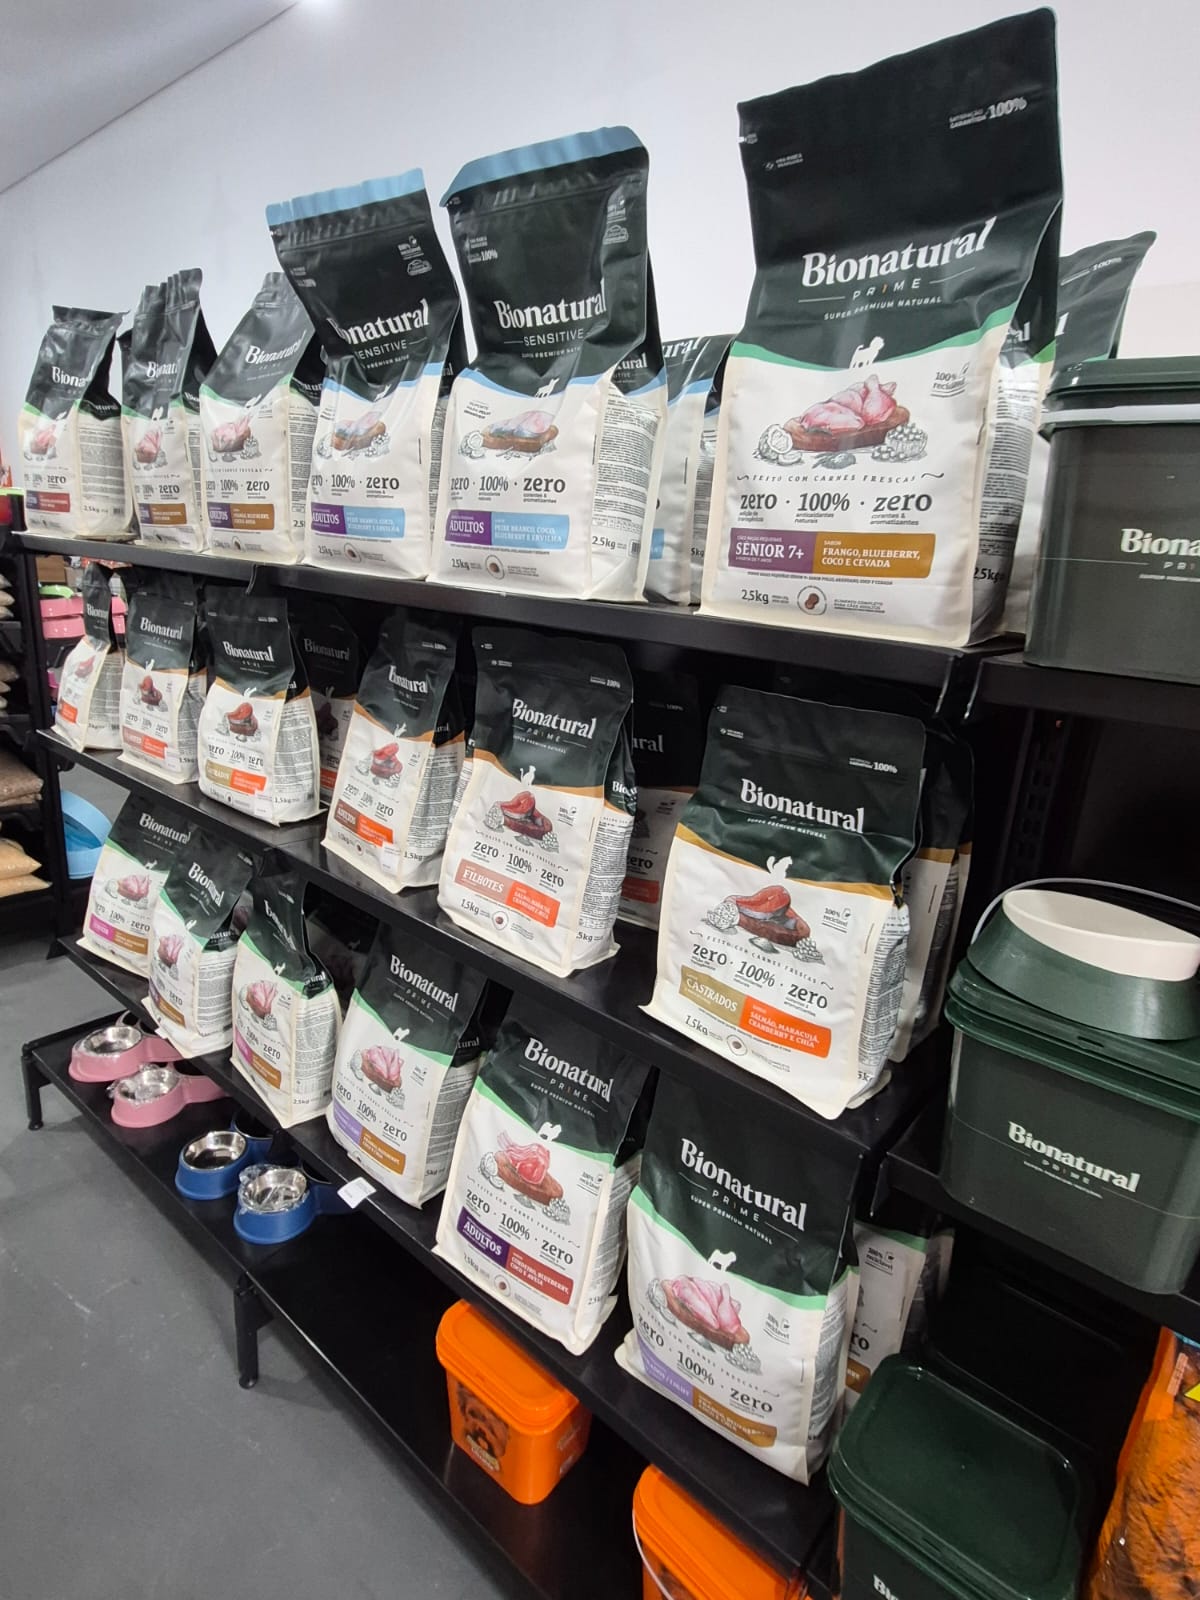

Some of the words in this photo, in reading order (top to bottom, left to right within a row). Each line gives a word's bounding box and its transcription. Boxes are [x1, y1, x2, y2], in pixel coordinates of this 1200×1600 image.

[802, 216, 997, 287] Bionatural
[494, 277, 607, 329] Bionatural
[852, 278, 921, 300] PRIME
[523, 328, 584, 346] SENSITIVE
[159, 484, 181, 494] zero
[246, 479, 270, 491] zero
[331, 474, 356, 488] 100%
[366, 476, 400, 490] zero
[478, 475, 509, 492] 100%
[523, 477, 566, 494] zero
[740, 493, 778, 510] zero
[797, 492, 850, 511] 100%
[873, 494, 932, 512] zero
[592, 535, 616, 550] 2.5kg
[735, 540, 785, 558] SÊNIOR
[788, 545, 804, 559] 7+
[823, 547, 861, 558] FRANGO,
[862, 548, 920, 560] BLUEBERRY,
[822, 557, 844, 566] COCO
[845, 558, 851, 566] E
[853, 558, 891, 568] CEVADA
[223, 641, 275, 662] Bionatural
[512, 698, 597, 739] Bionatural
[873, 761, 898, 774] 100%
[740, 778, 865, 834] Bionatural
[139, 812, 191, 844] Bionatural
[474, 841, 498, 858] zero
[508, 853, 532, 872] 100%
[541, 869, 564, 887] zero
[462, 868, 505, 893] FILHOTES
[131, 920, 150, 932] zero
[390, 954, 459, 1013] Bionatural
[693, 943, 727, 966] zero
[736, 961, 775, 988] 100%
[788, 984, 828, 1009] zero
[686, 977, 738, 1013] CASTRADOS
[524, 1037, 615, 1102] Bionatural
[550, 1078, 588, 1102] PRIME
[357, 1100, 376, 1121] 100%
[383, 1122, 408, 1142] zero
[1008, 1120, 1141, 1193] Bionatural
[680, 1138, 808, 1231] Bionatural
[712, 1189, 760, 1222] PRIME
[463, 1221, 502, 1256] ADULTOS
[466, 1189, 490, 1213] zero
[500, 1213, 530, 1240] 100%
[541, 1240, 574, 1265] zero
[639, 1314, 665, 1347] zero
[677, 1351, 715, 1386] 100%
[730, 1387, 773, 1413] zero
